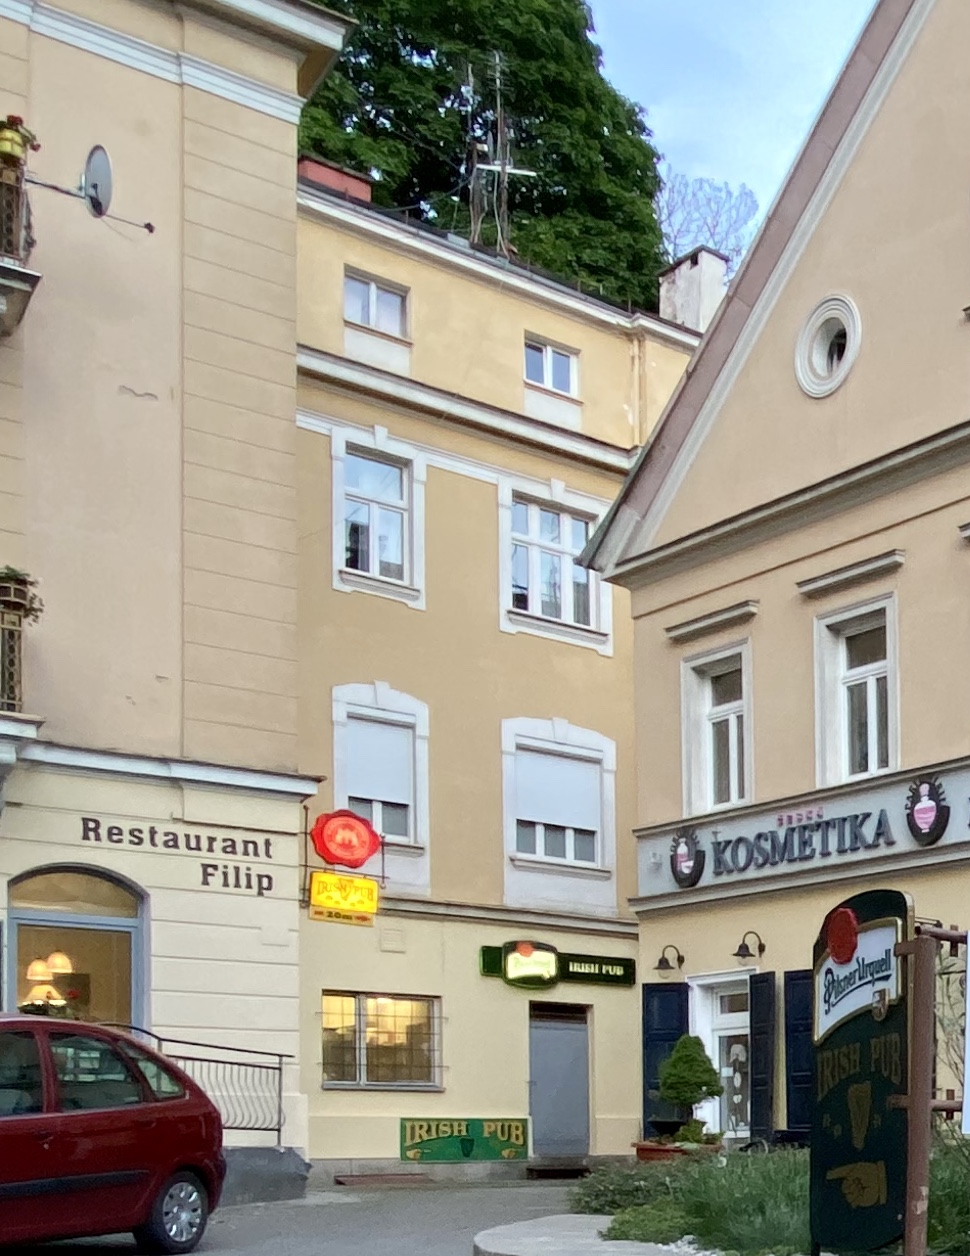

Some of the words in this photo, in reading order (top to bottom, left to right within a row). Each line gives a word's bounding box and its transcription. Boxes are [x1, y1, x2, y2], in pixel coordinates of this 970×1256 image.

[81, 817, 273, 859] Restaurant
[711, 809, 897, 876] KOSMETIKA
[200, 863, 273, 897] Filip
[569, 961, 599, 974] IRISH
[602, 964, 624, 976] PUB
[824, 966, 857, 1015] Pilsner
[856, 949, 892, 986] Urquell
[817, 1042, 861, 1100] IRISH
[870, 1032, 901, 1086] PUB
[404, 1121, 468, 1147] IRISH
[482, 1121, 524, 1146] PUB
